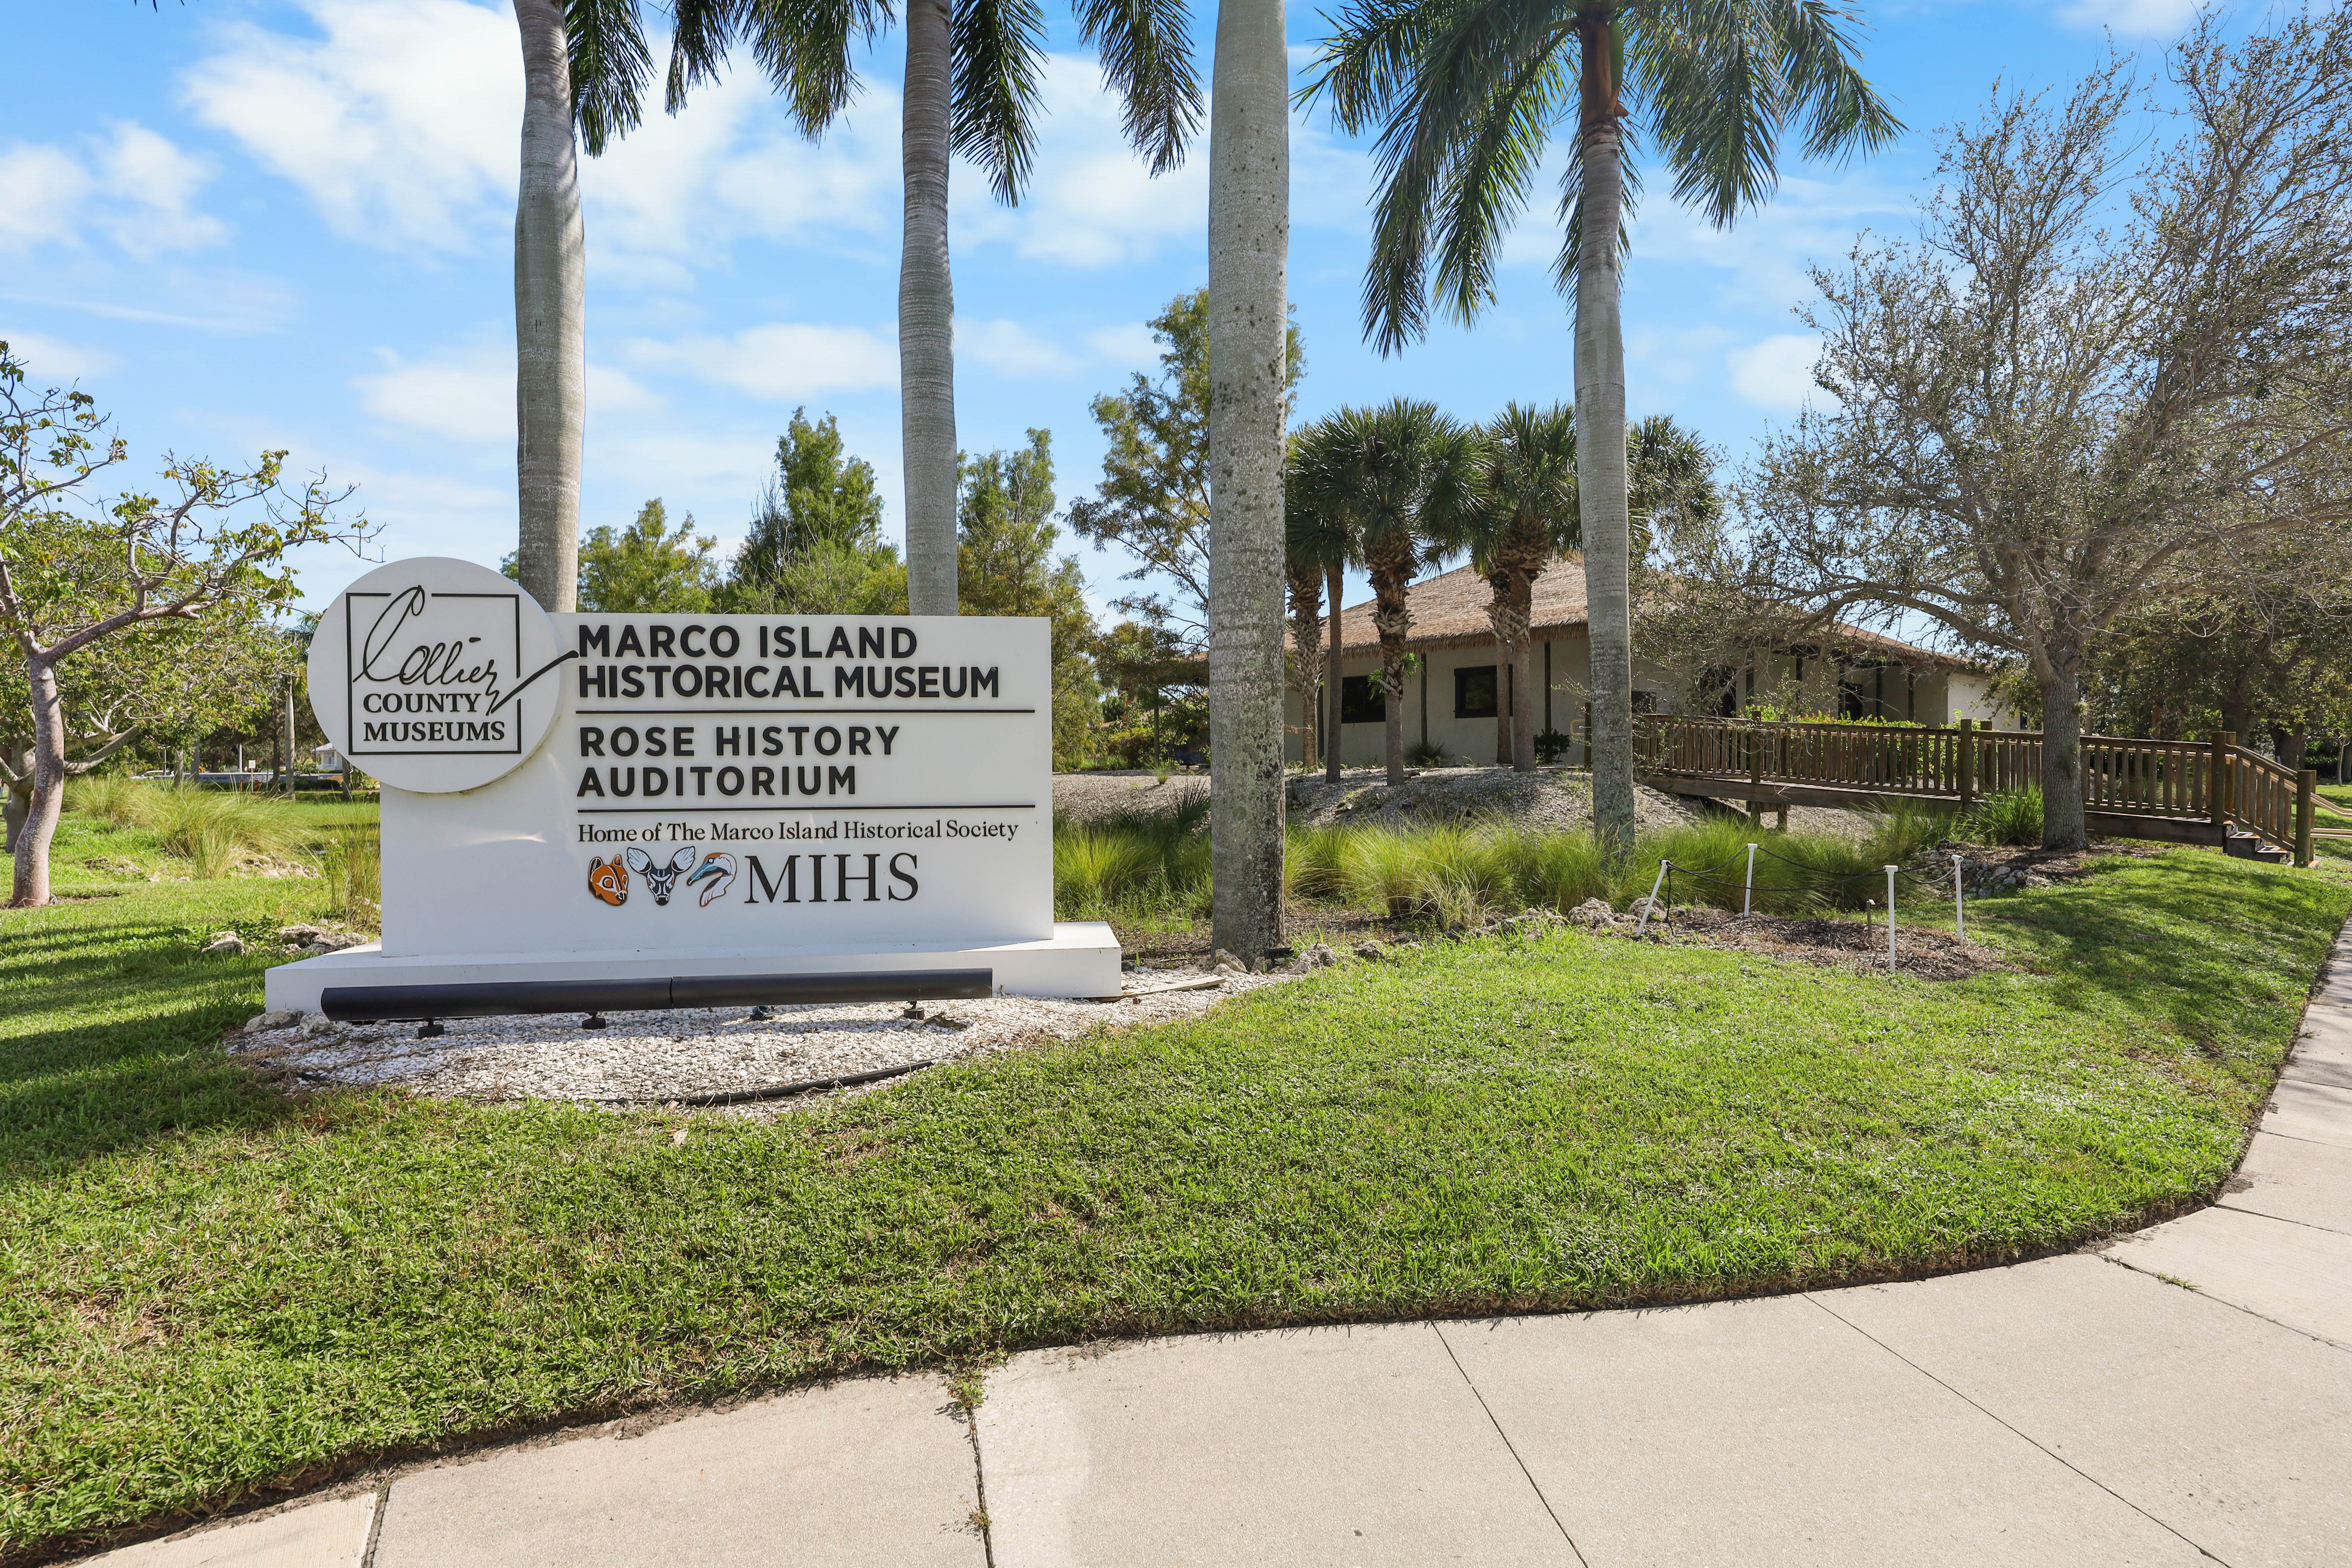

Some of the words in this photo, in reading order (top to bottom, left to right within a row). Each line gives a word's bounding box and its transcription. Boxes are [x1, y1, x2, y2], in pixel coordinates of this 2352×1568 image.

[353, 585, 579, 716] Collier
[579, 625, 740, 658] MARCO
[760, 626, 917, 658] ISLAND
[579, 665, 824, 698] HISTORICAL
[835, 666, 998, 698] MUSEUM
[363, 693, 481, 713] COUNTY
[363, 721, 505, 742] MUSEUMS
[580, 726, 694, 757] ROSE
[716, 726, 900, 756] HISTORY
[576, 766, 855, 797] AUDITORIUM
[578, 824, 637, 842] Home
[642, 822, 662, 841] of
[667, 822, 705, 841] The
[710, 823, 773, 840] Marco
[779, 820, 838, 839] Island
[844, 819, 942, 839] Historical
[946, 820, 1019, 841] Society
[744, 853, 918, 903] MIHS
